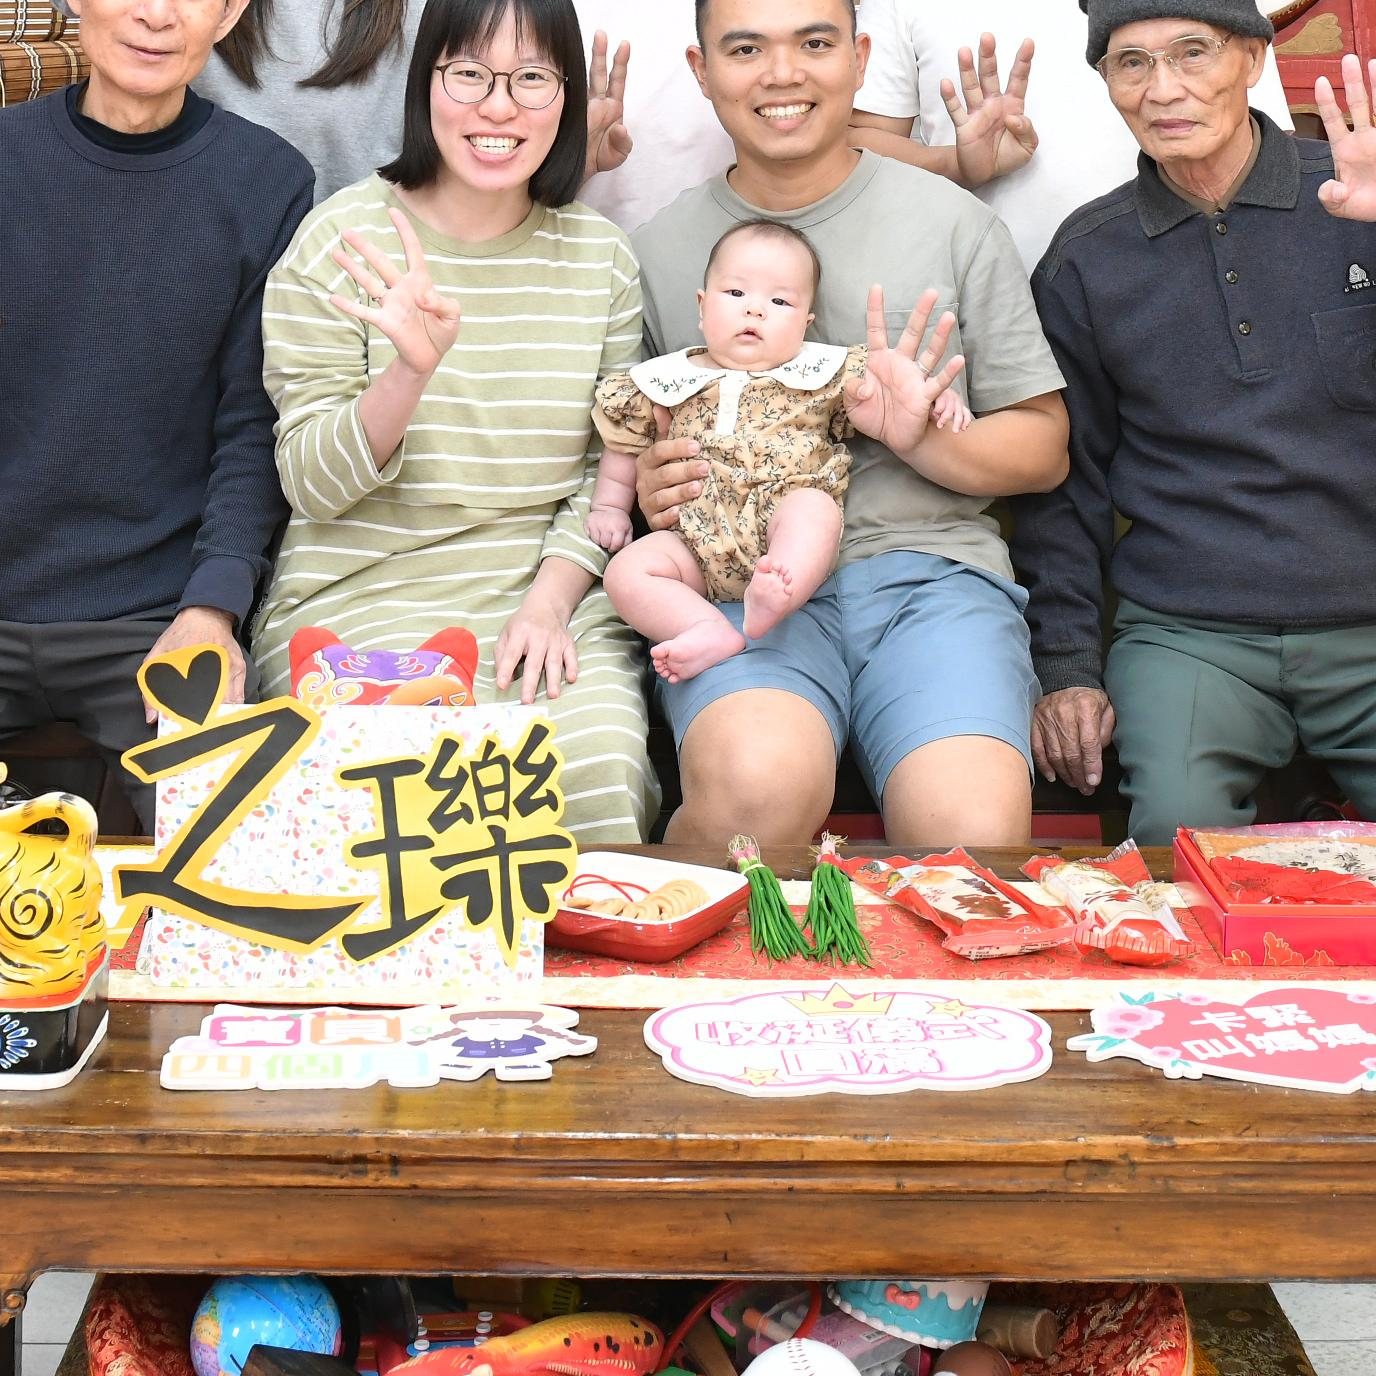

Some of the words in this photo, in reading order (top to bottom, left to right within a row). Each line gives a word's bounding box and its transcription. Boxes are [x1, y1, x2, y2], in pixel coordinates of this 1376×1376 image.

[695, 1015, 1007, 1046] 收涎儀式
[170, 1052, 430, 1081] 四個月
[781, 1046, 943, 1076] 圓滿
